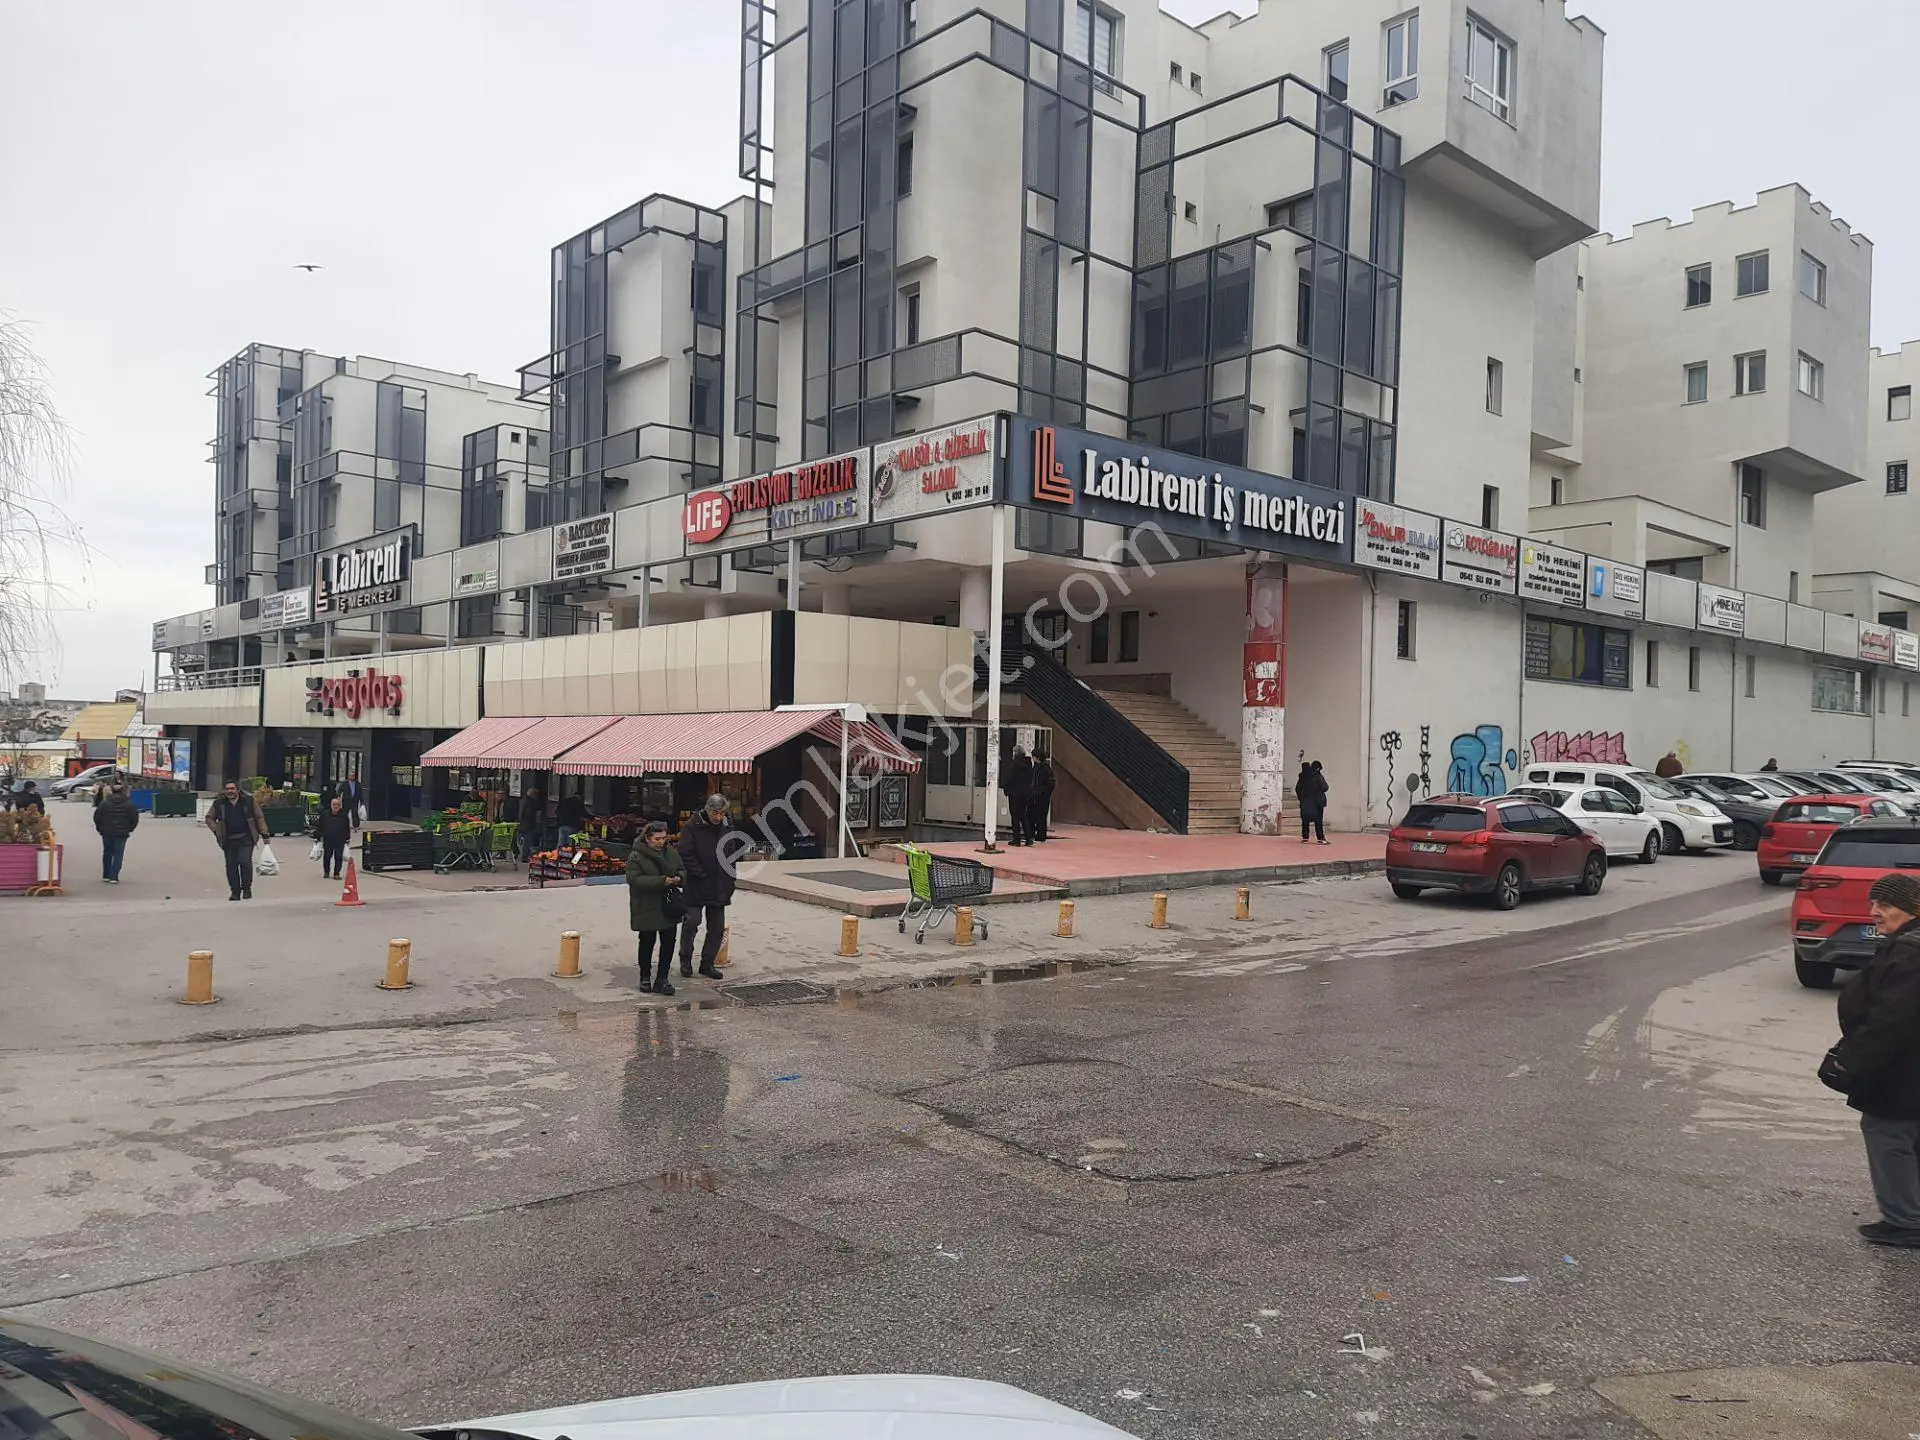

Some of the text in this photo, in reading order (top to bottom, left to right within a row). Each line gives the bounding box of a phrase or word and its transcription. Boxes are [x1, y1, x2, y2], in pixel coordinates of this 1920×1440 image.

[921, 466, 958, 494] SALONU
[1083, 449, 1345, 544] Labirent iş merkezi
[686, 498, 722, 534] LIFE
[331, 535, 402, 594] Labirent
[1367, 541, 1385, 551] arsa
[1391, 545, 1410, 556] daire
[1536, 551, 1551, 565] DİŞ
[1553, 557, 1581, 571] HEKİMİ
